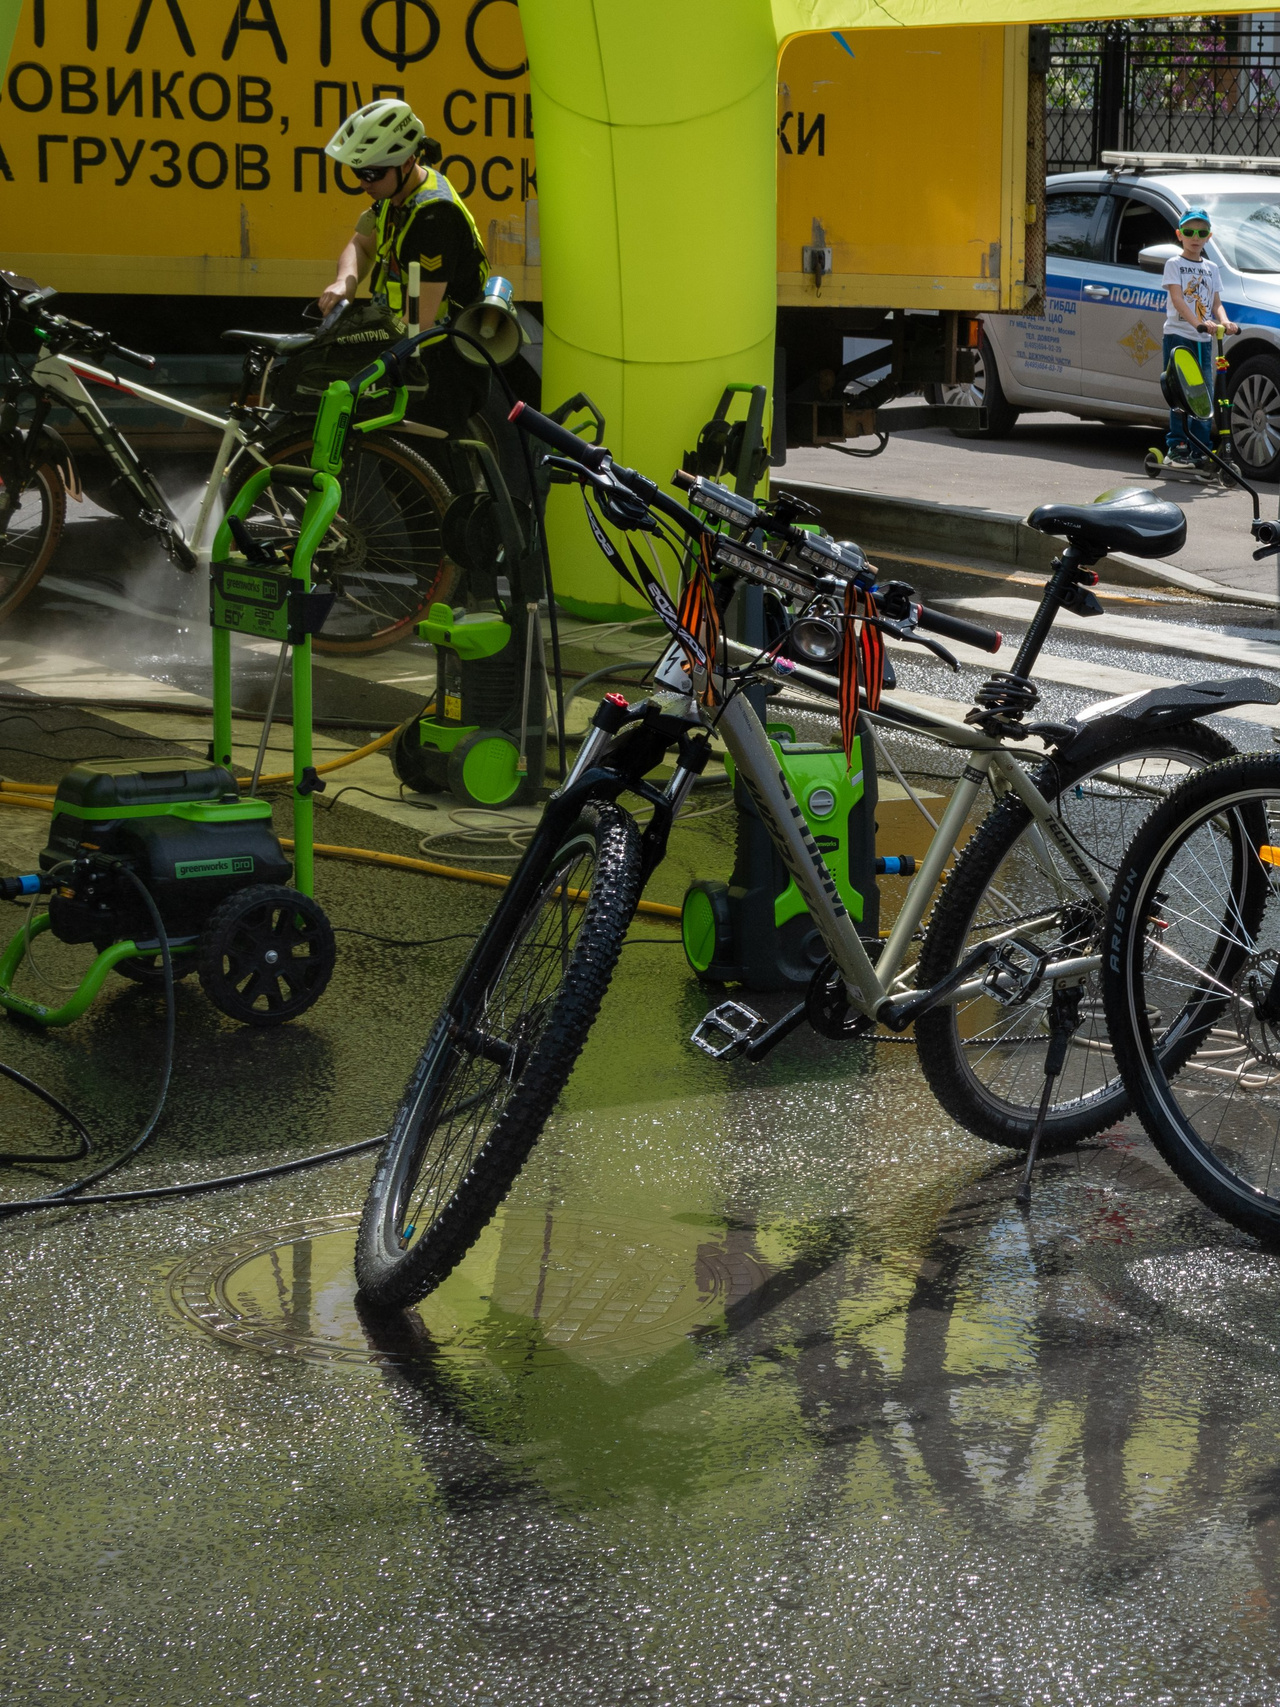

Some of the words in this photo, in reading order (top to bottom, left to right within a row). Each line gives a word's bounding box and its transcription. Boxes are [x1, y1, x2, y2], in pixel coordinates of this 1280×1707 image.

[8, 61, 290, 135] ОВИКОВ,
[443, 89, 535, 139] СП
[777, 111, 825, 157] КИ
[38, 134, 271, 191] ГРУЗОВ
[1050, 300, 1077, 314] ГИБДД
[1110, 287, 1167, 312] ПОЛИЦИ
[1048, 314, 1063, 324] ЦАО
[180, 860, 229, 876] greenworks
[233, 859, 251, 872] pro
[1109, 866, 1139, 974] ARISUN
